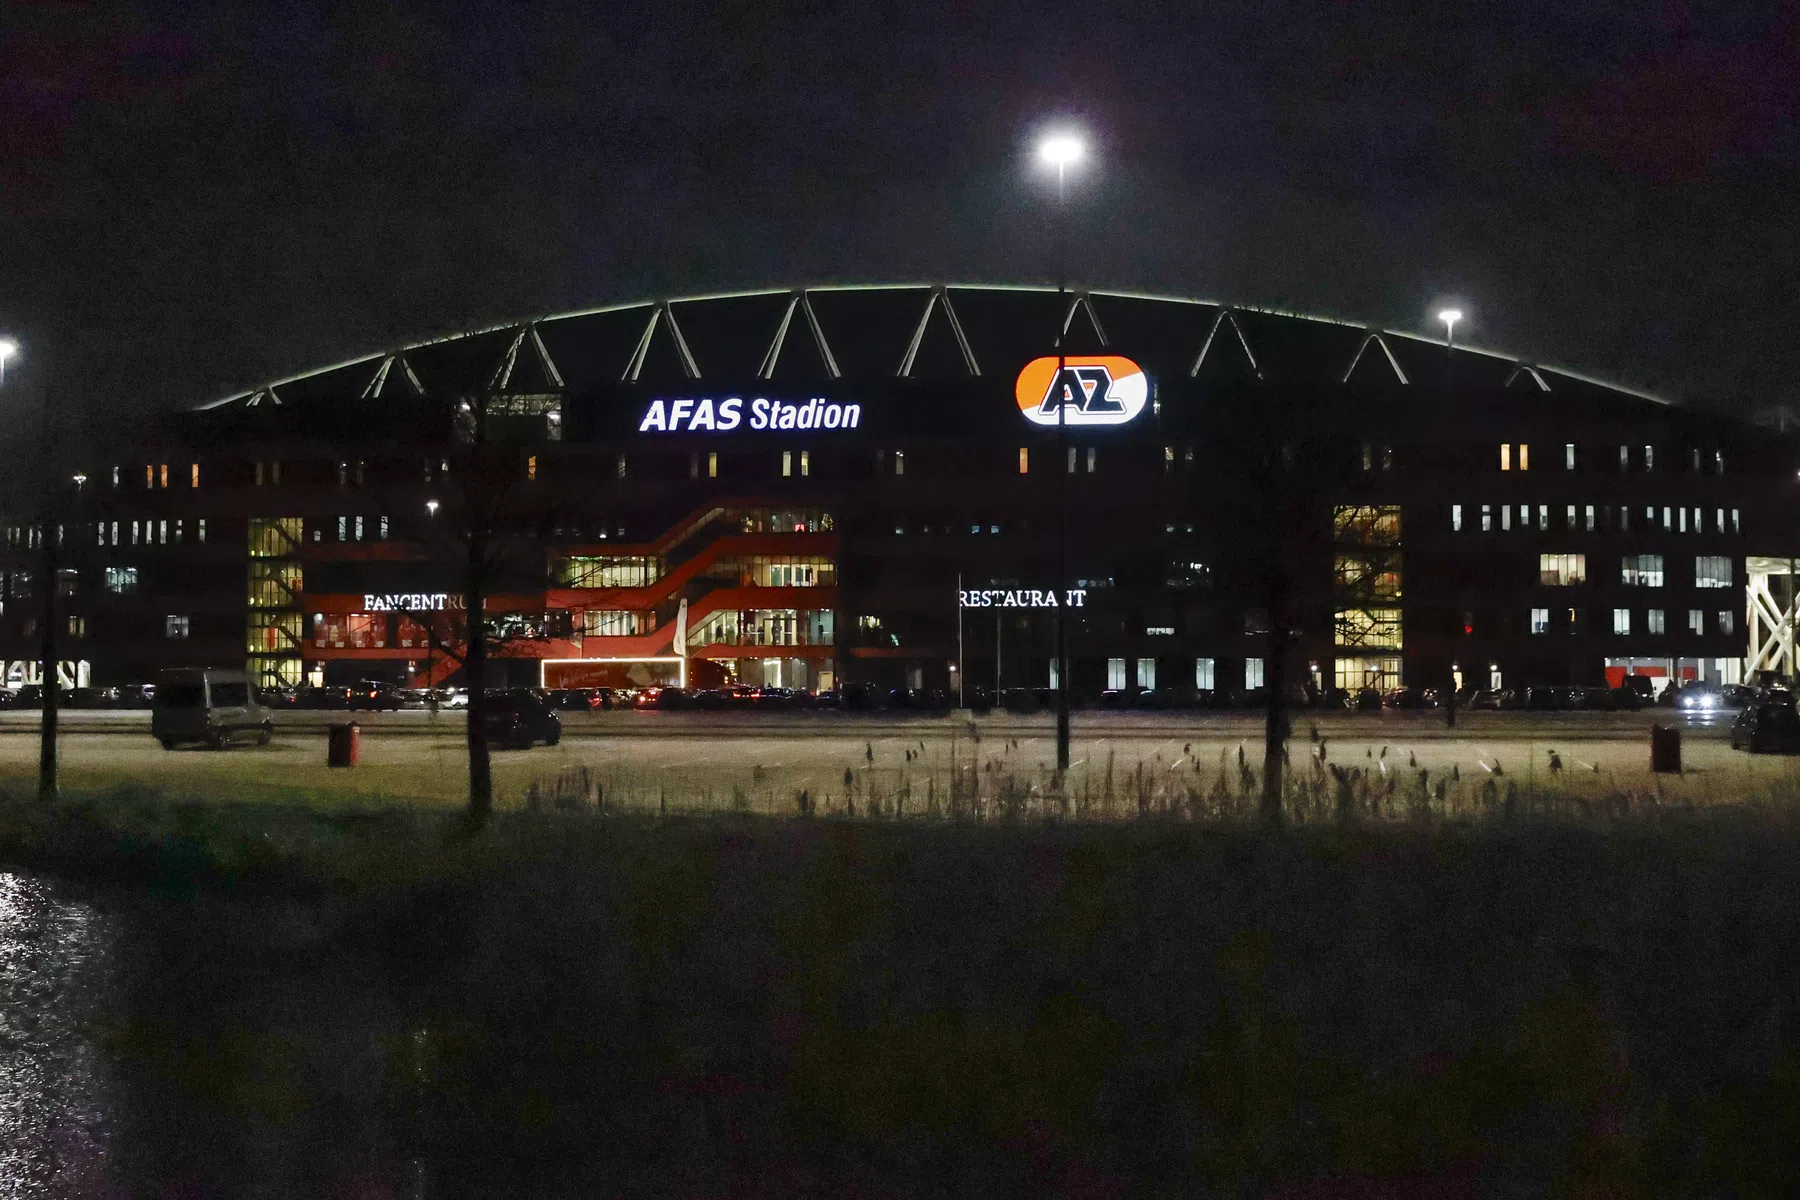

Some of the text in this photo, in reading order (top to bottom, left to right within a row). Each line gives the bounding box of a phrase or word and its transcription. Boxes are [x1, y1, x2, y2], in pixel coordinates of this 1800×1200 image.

[1038, 365, 1127, 415] AZ
[638, 397, 861, 432] AFAS Stadion
